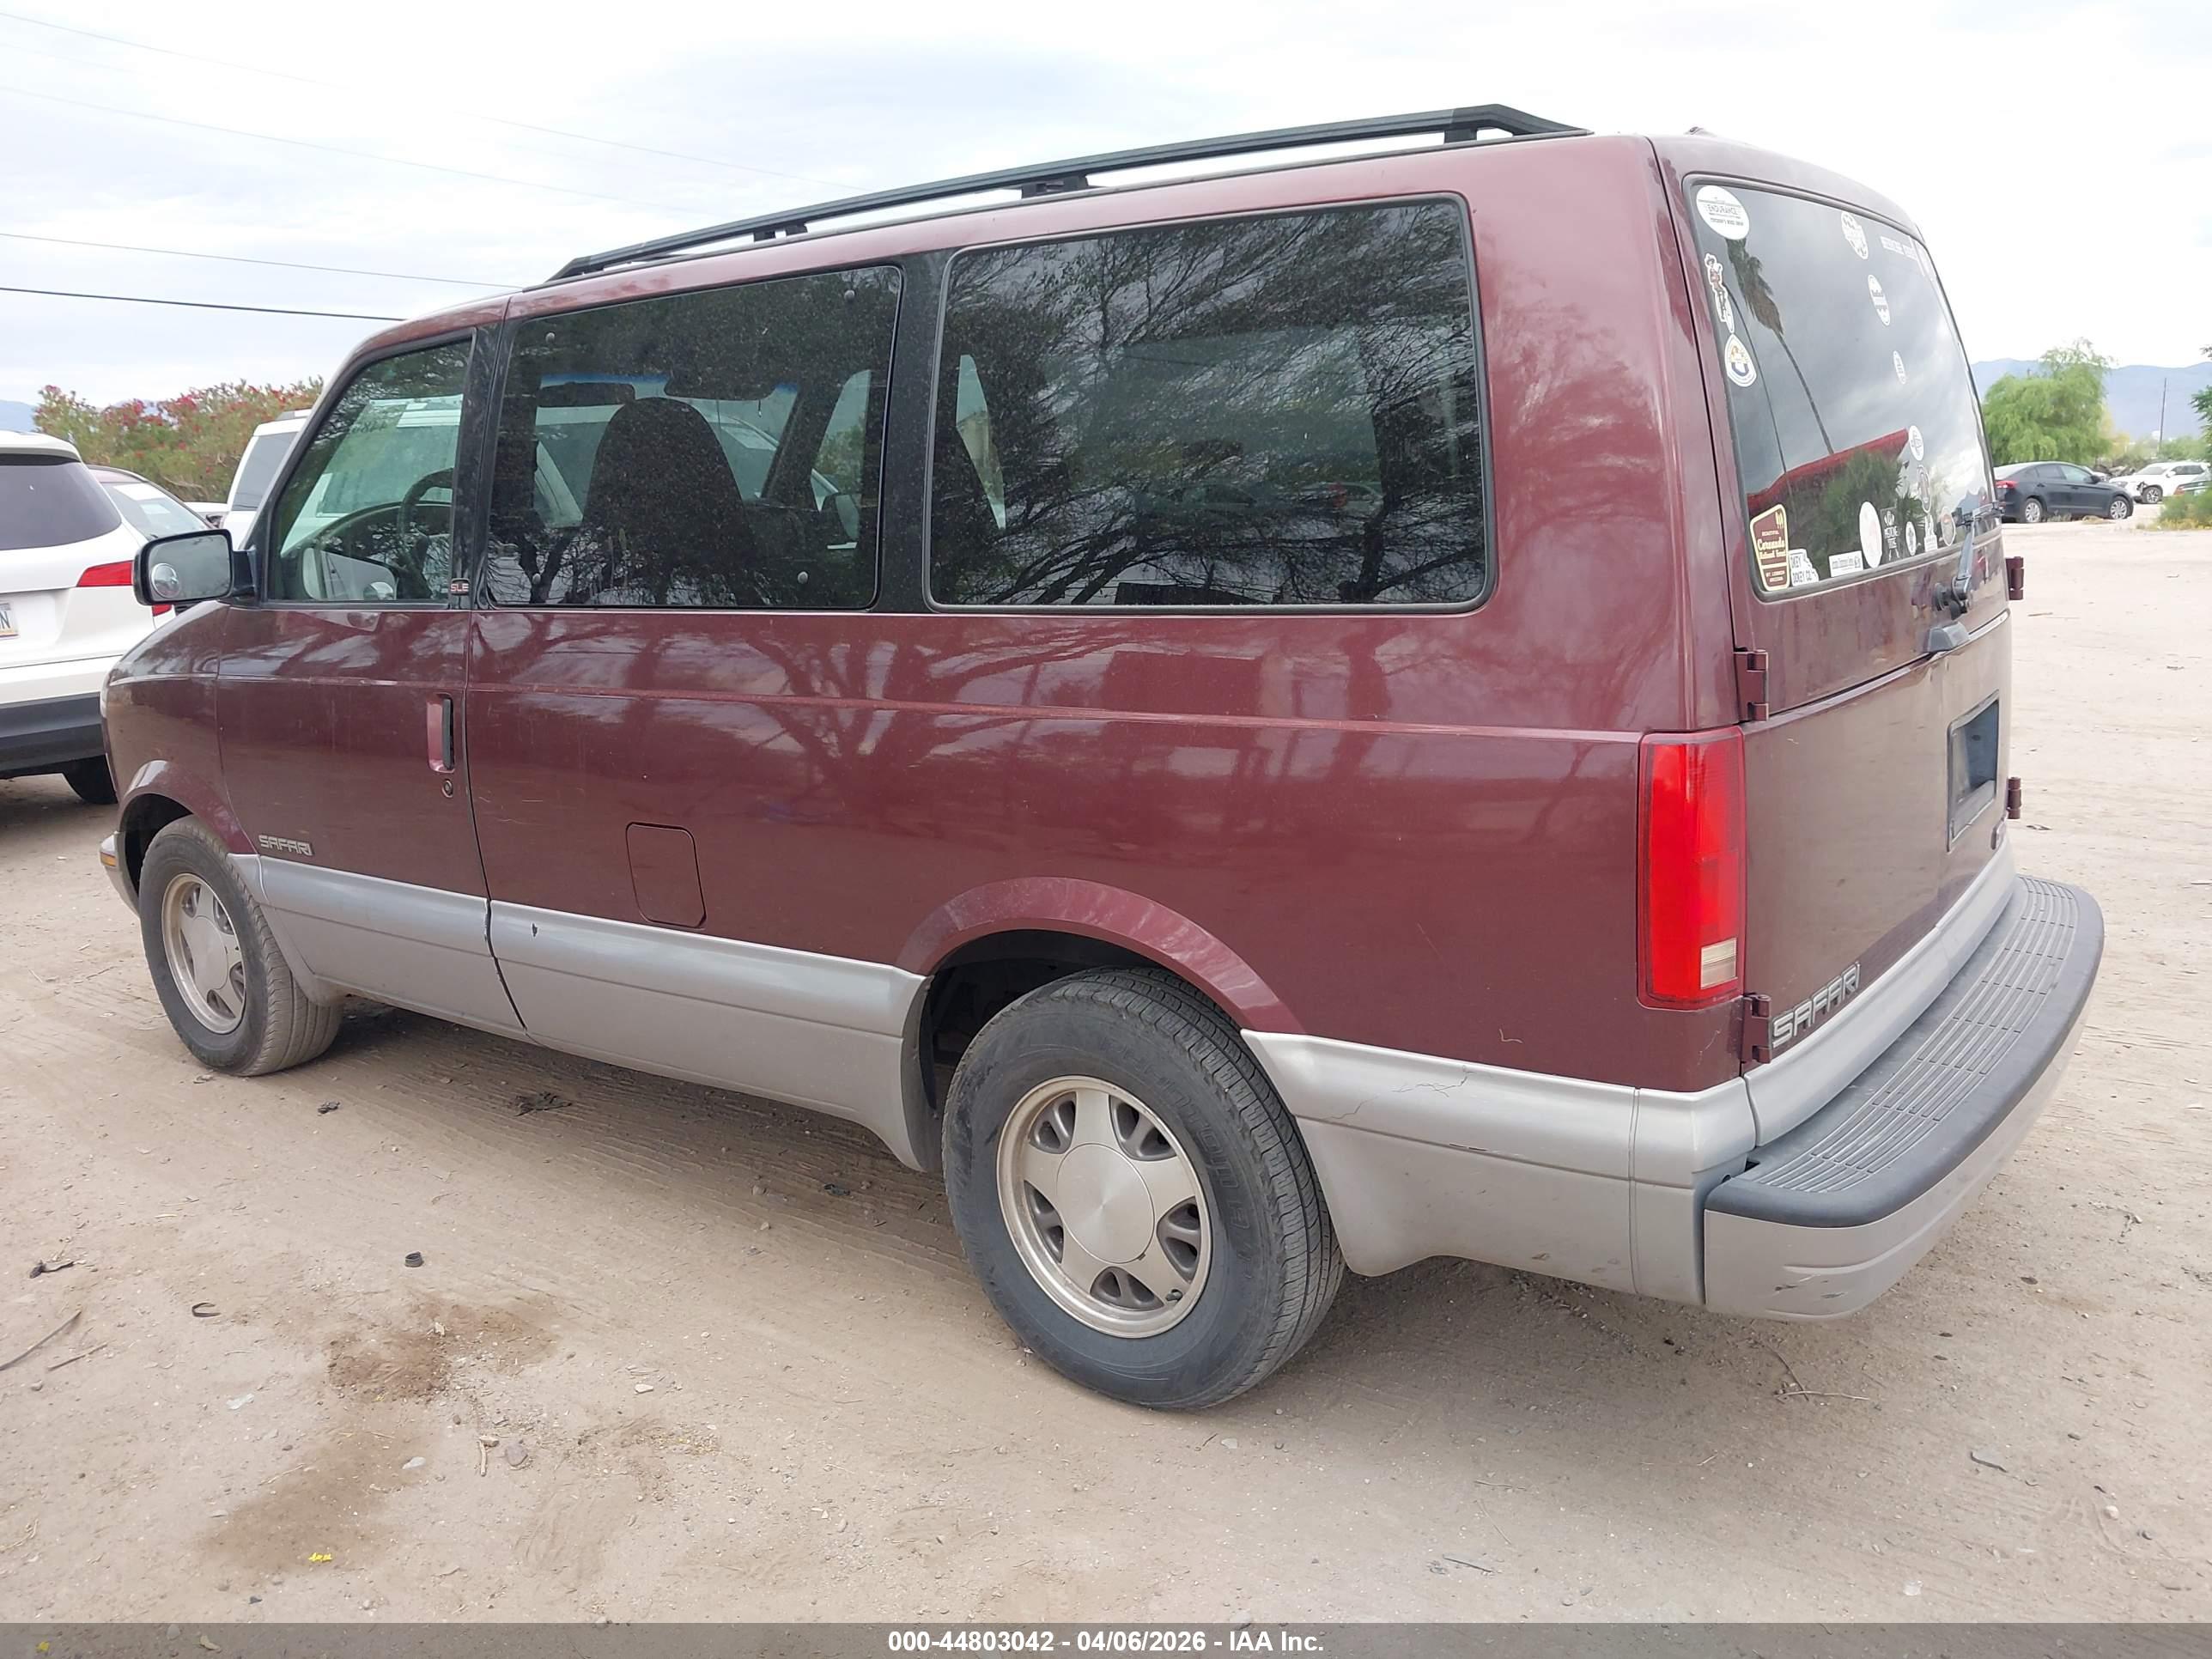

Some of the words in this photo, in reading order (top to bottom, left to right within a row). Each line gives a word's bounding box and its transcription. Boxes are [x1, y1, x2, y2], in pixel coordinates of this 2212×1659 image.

[450, 583, 470, 592] SLE
[258, 834, 313, 856] SAFARI
[1772, 960, 1861, 1048] SAFARI
